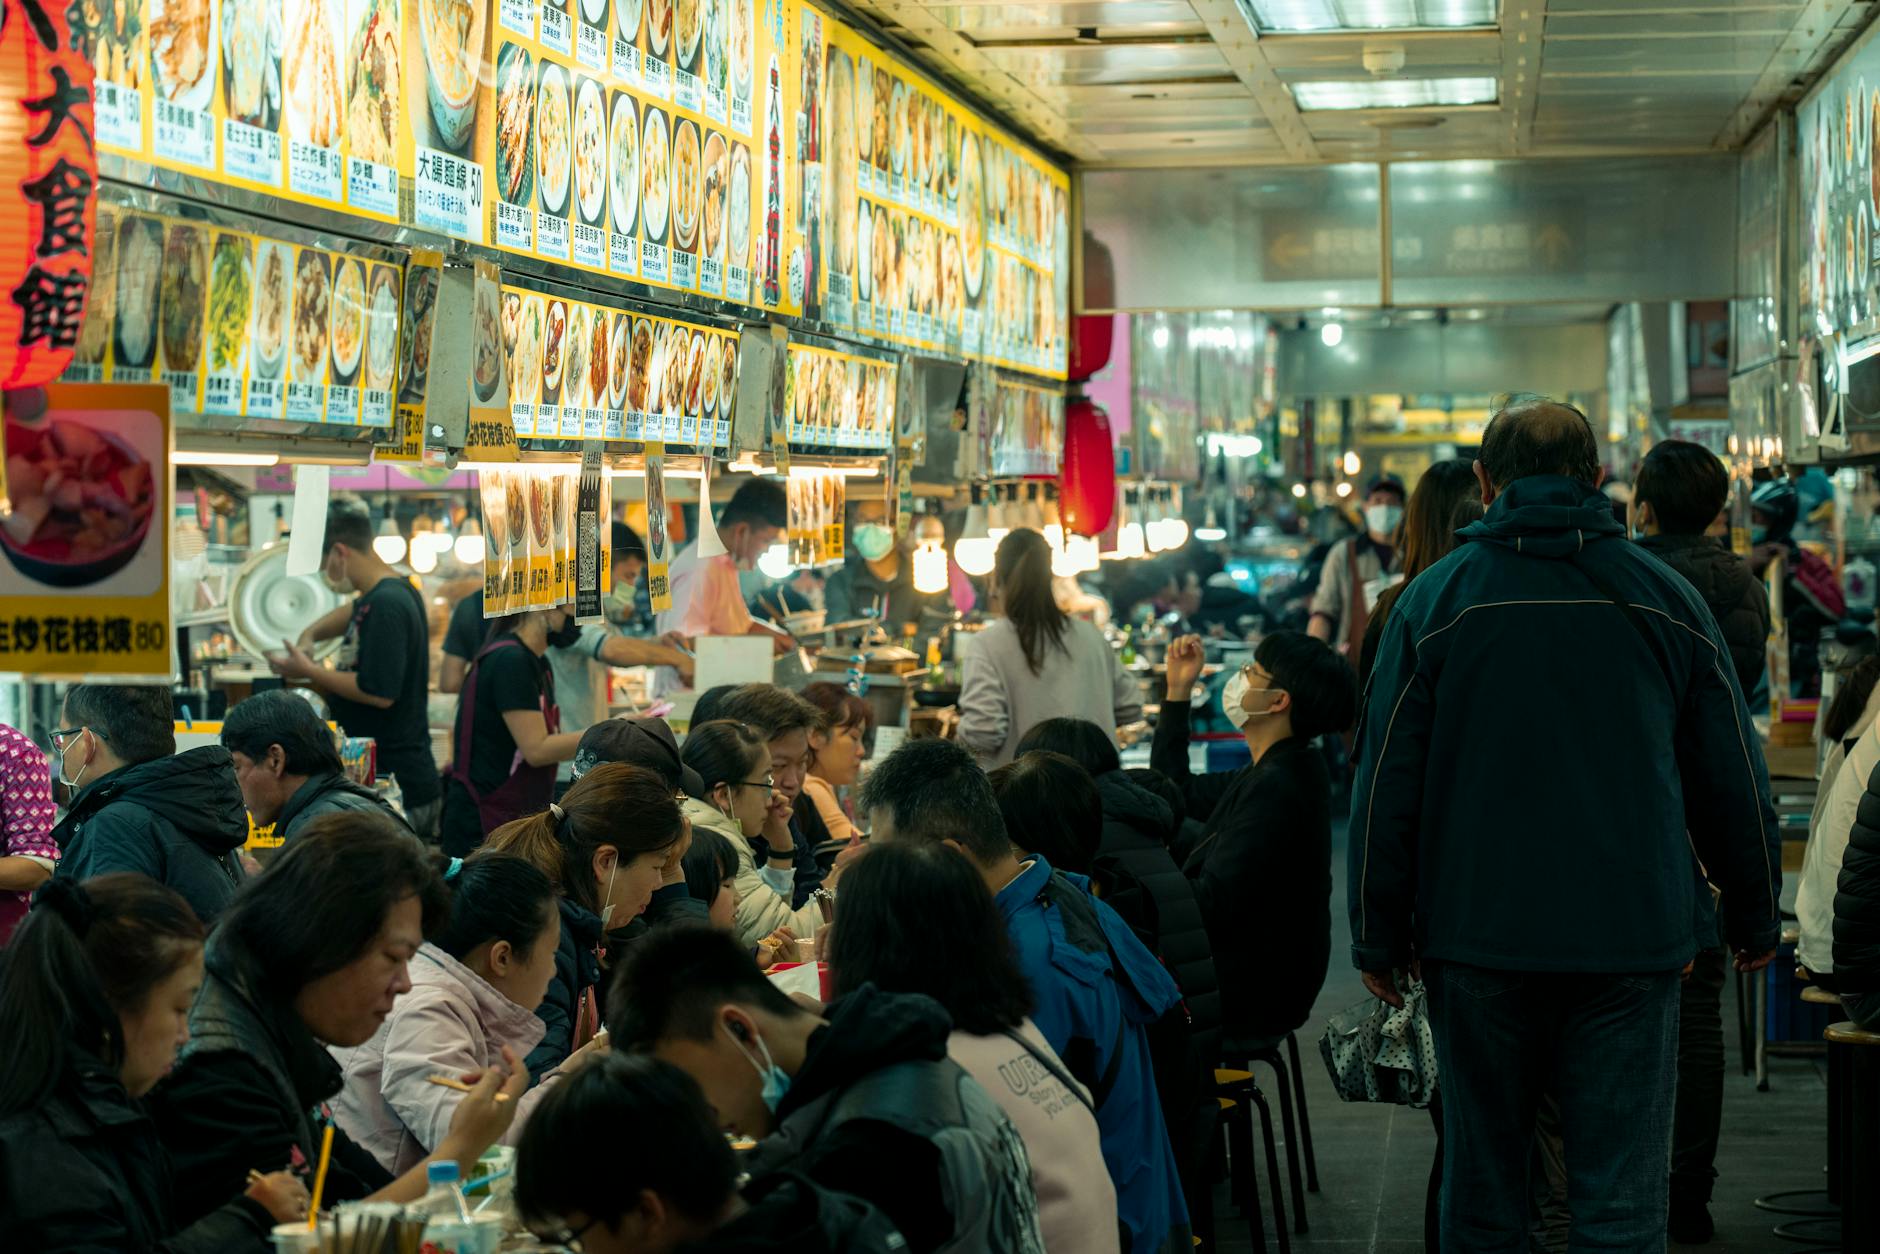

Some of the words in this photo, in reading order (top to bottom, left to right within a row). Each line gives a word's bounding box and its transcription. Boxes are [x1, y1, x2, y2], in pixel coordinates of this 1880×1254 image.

[418, 150, 467, 191] 大腸麵線
[471, 167, 482, 208] 50
[135, 621, 166, 651] 80
